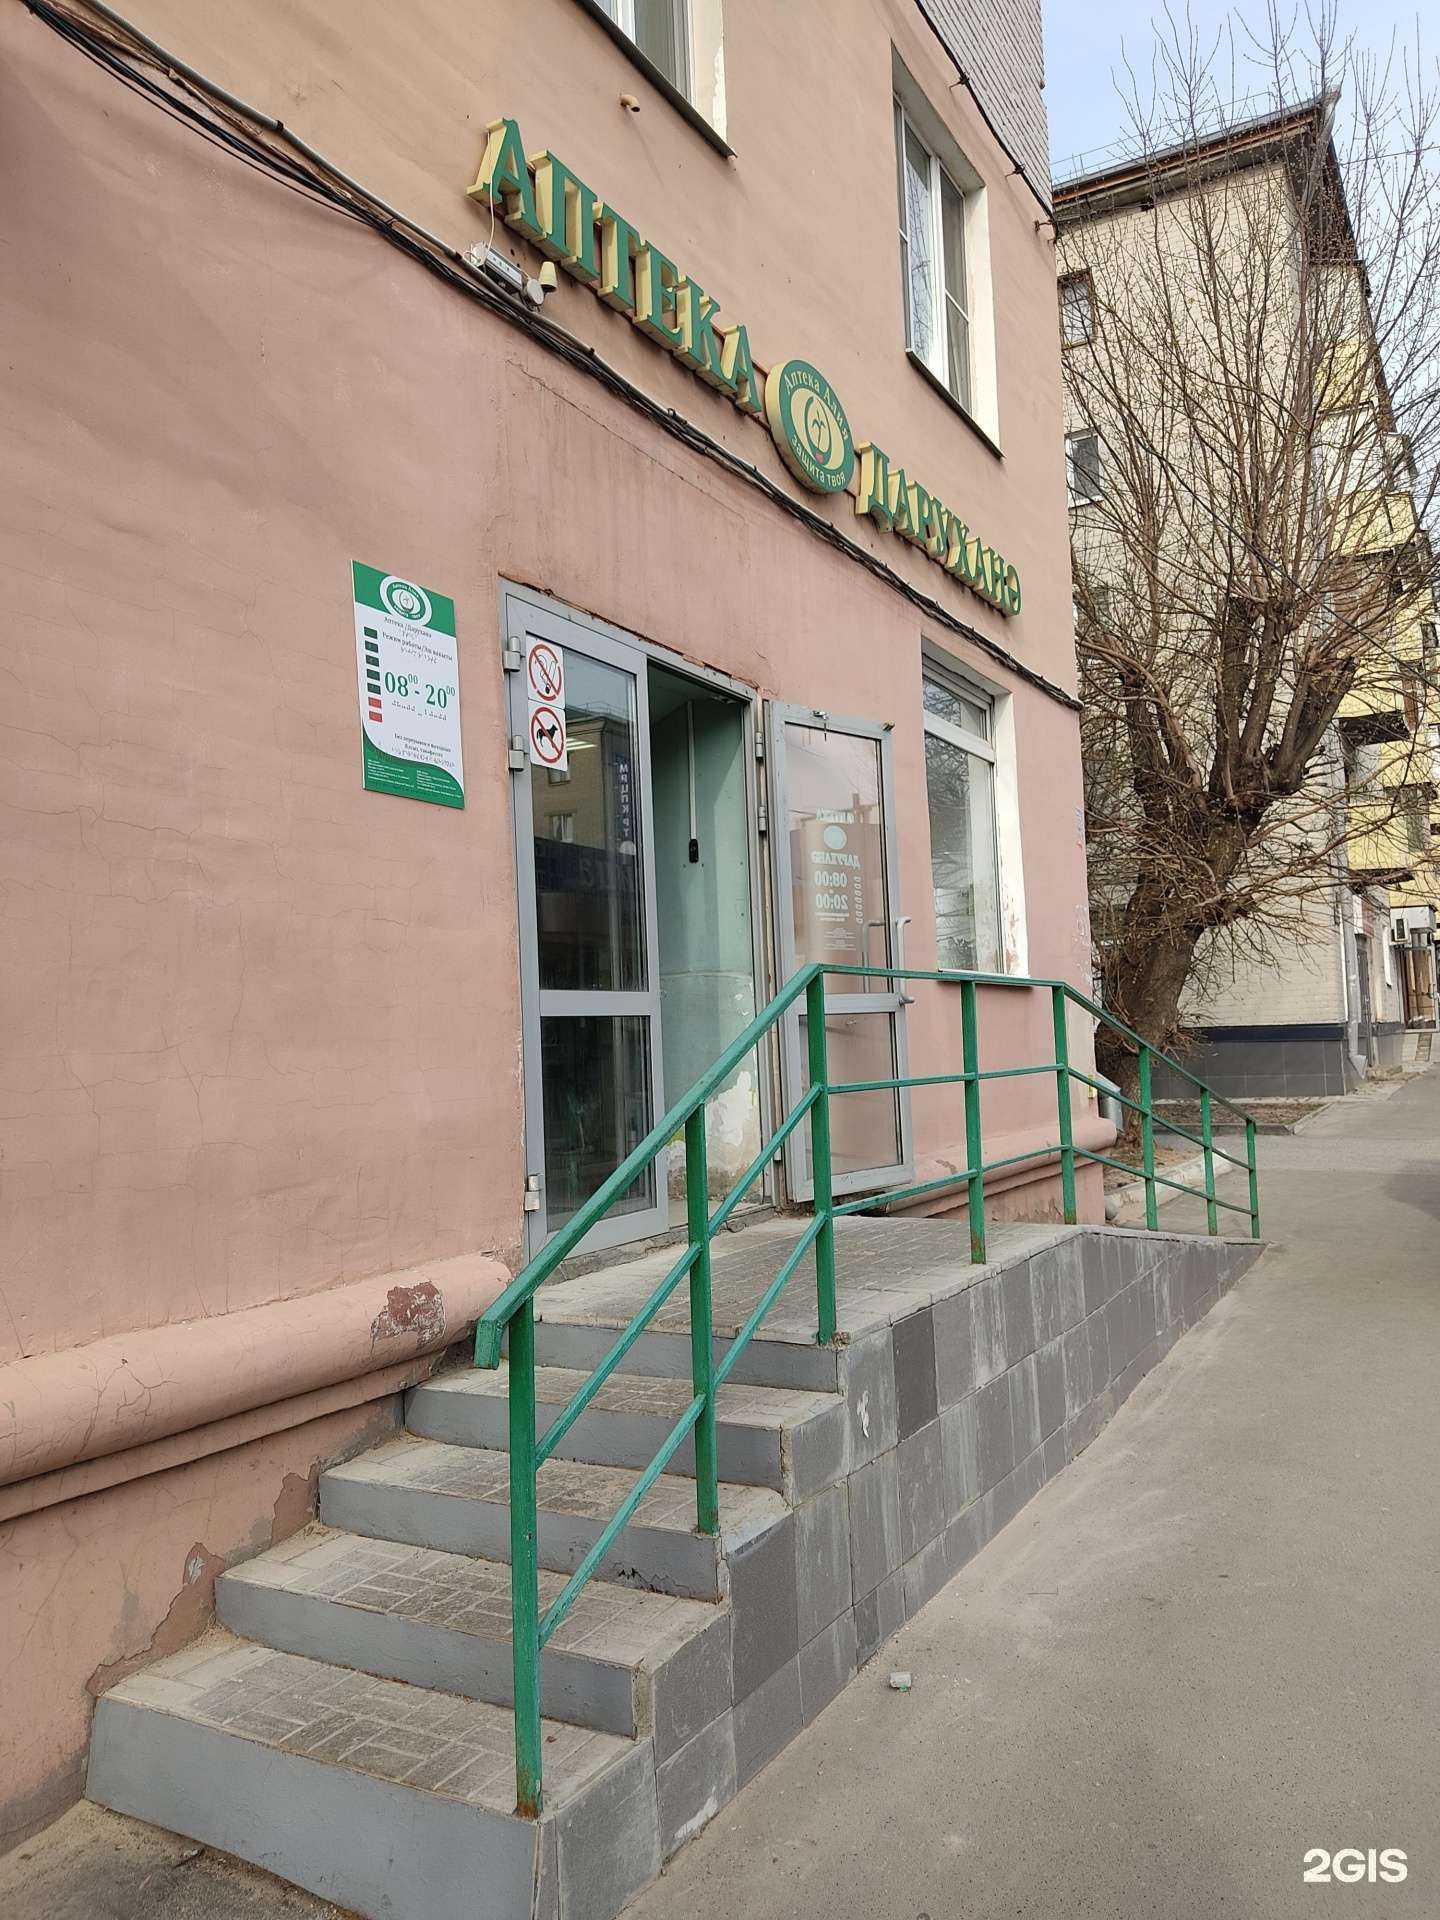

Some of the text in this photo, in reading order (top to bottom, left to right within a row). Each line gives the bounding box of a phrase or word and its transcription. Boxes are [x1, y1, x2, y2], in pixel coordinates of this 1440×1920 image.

[467, 117, 763, 415] АПТЕКА
[783, 370, 849, 441] Аптека Алия
[790, 434, 847, 488] защита твоя
